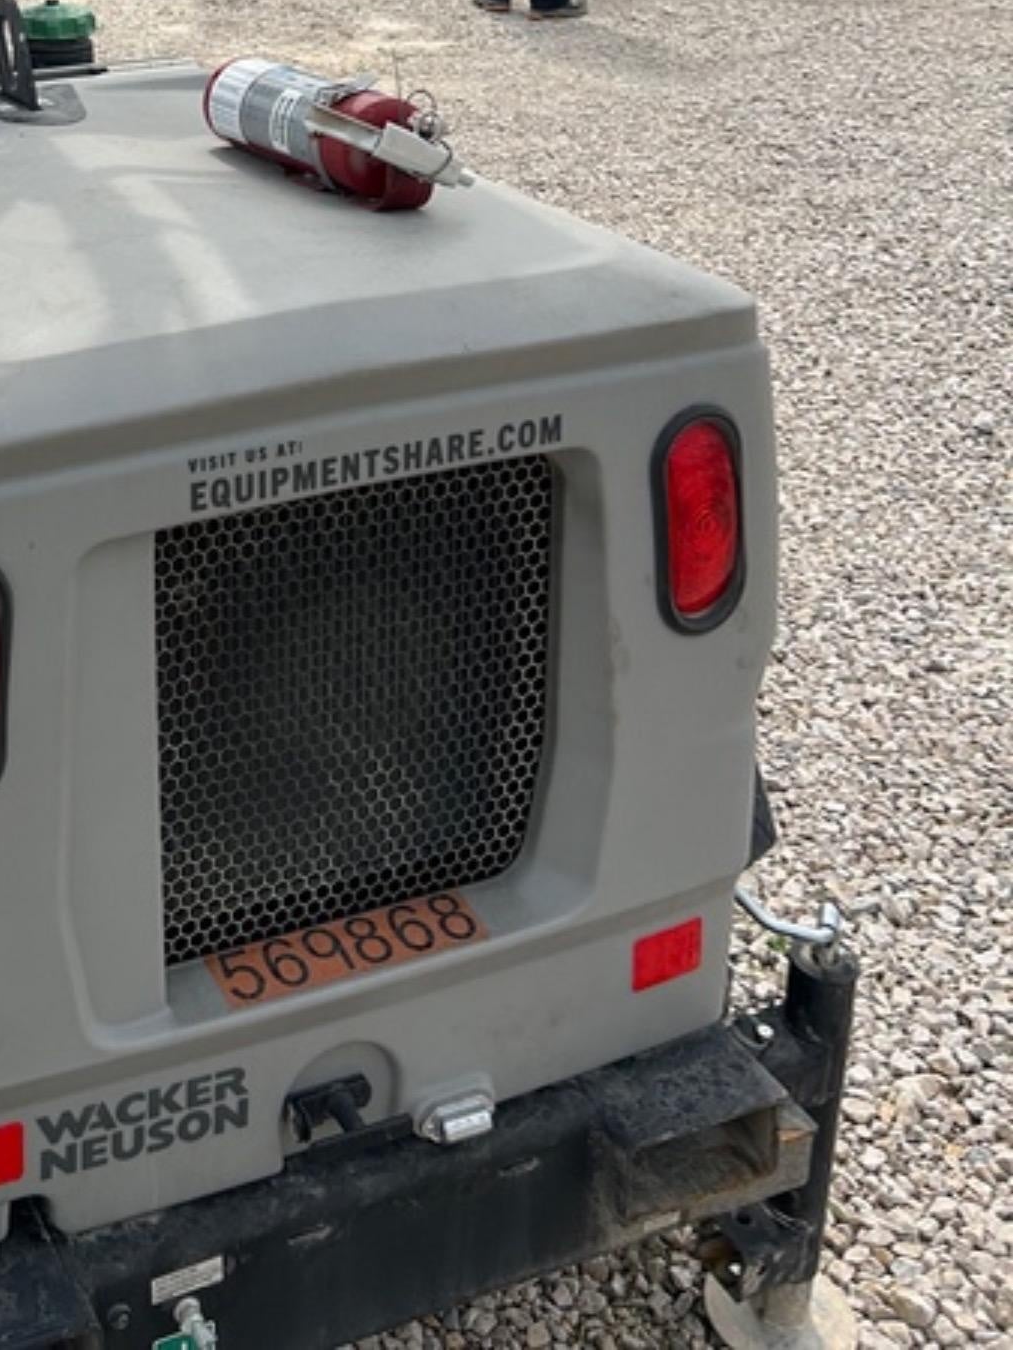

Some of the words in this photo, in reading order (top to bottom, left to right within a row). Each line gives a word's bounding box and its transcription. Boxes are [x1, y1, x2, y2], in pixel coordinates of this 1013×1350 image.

[187, 451, 236, 473] VISIT
[244, 446, 267, 463] US
[189, 413, 564, 512] EQUIPMENTSHARE.COM
[217, 893, 477, 1000] 569868
[36, 1067, 248, 1145] WACKER
[40, 1097, 249, 1181] NEUSON
